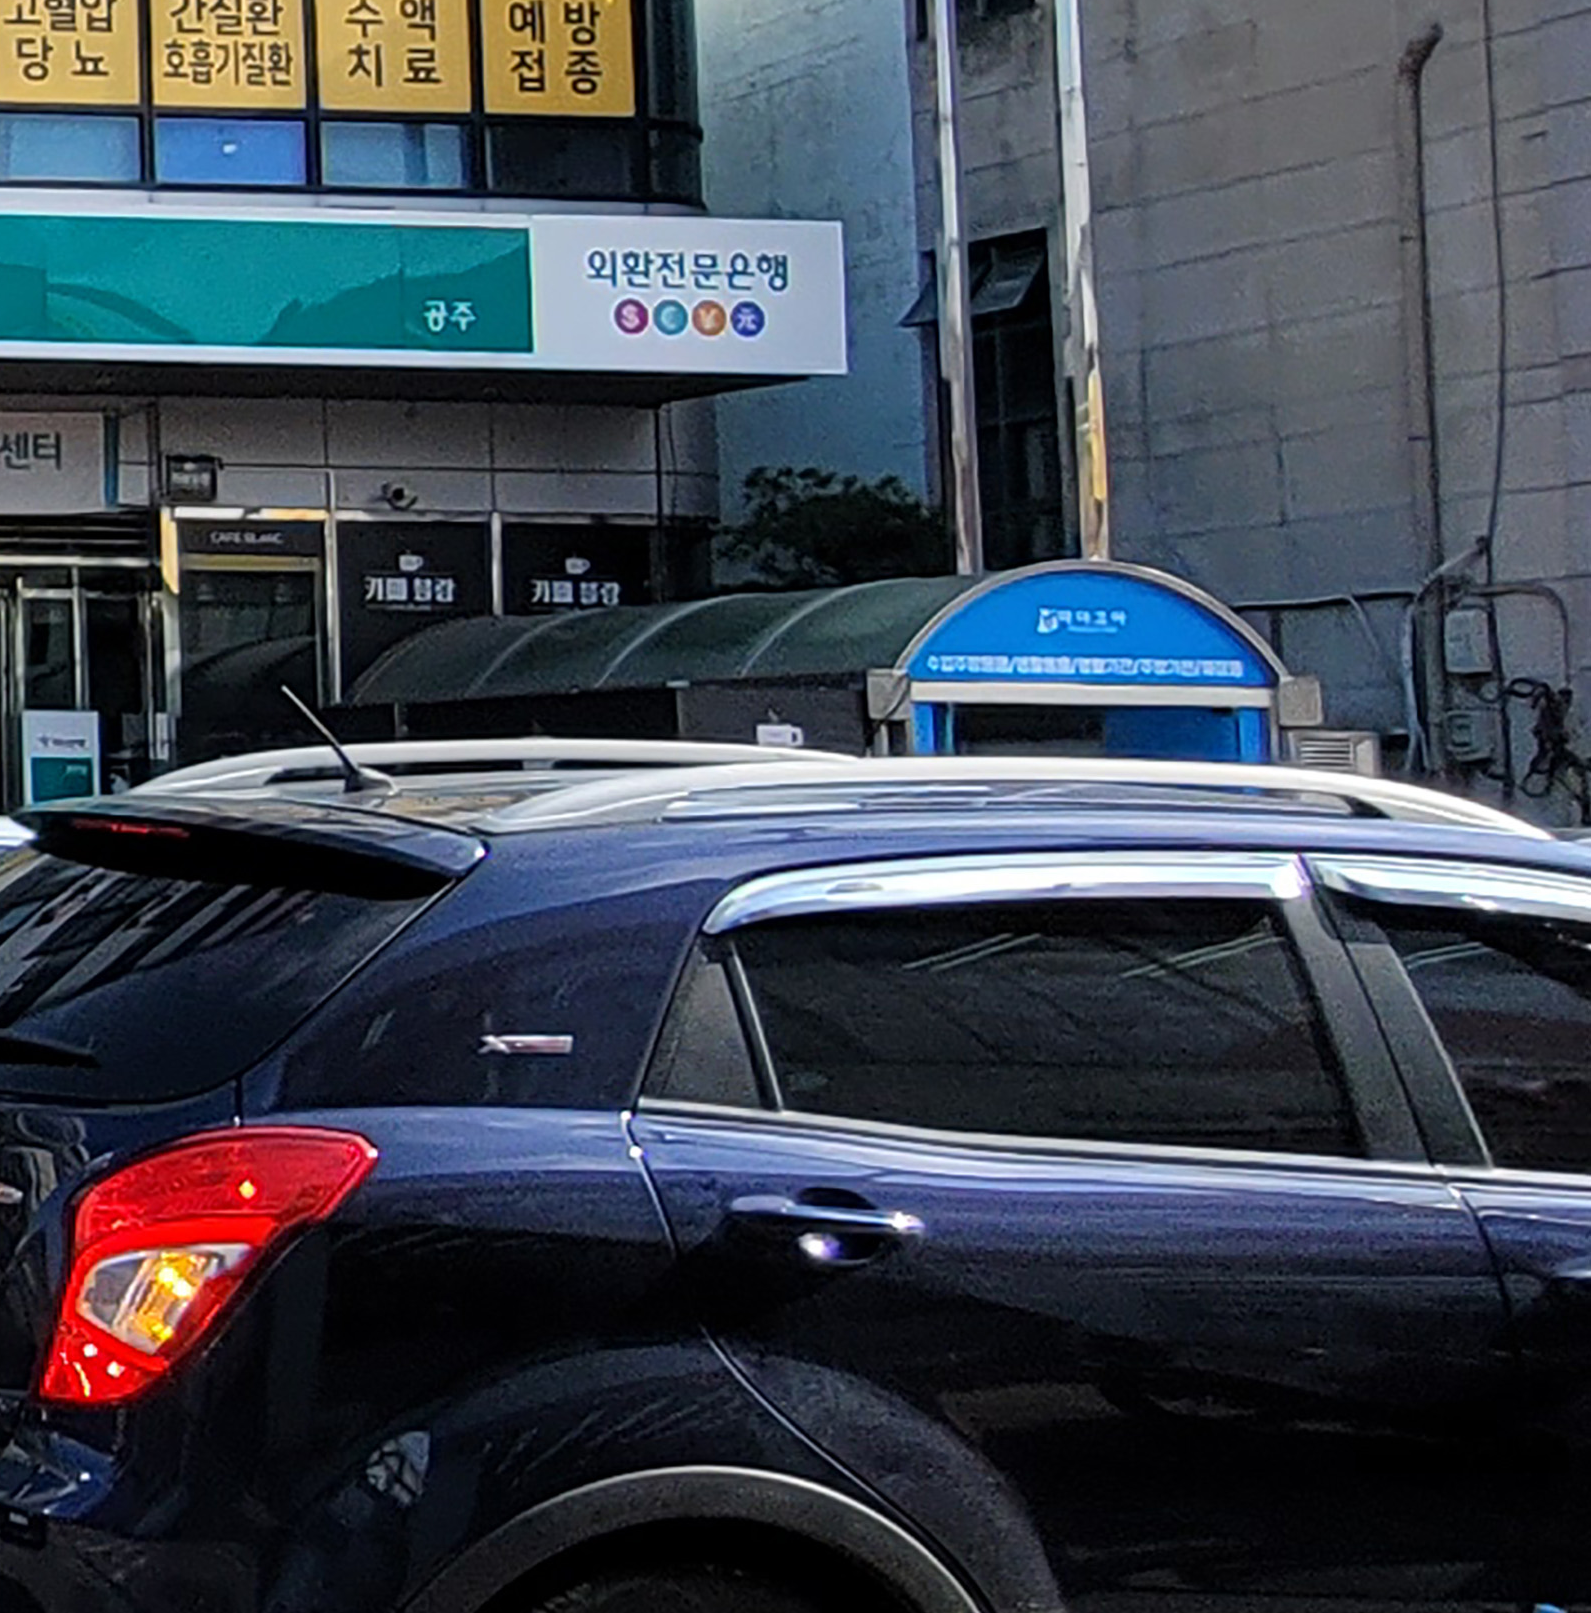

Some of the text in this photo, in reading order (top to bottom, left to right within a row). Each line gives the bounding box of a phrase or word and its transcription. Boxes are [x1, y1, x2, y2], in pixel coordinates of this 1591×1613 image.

[162, 40, 295, 87] 호흡기질환
[587, 249, 789, 291] 외환전문은행
[423, 299, 477, 334] 공주
